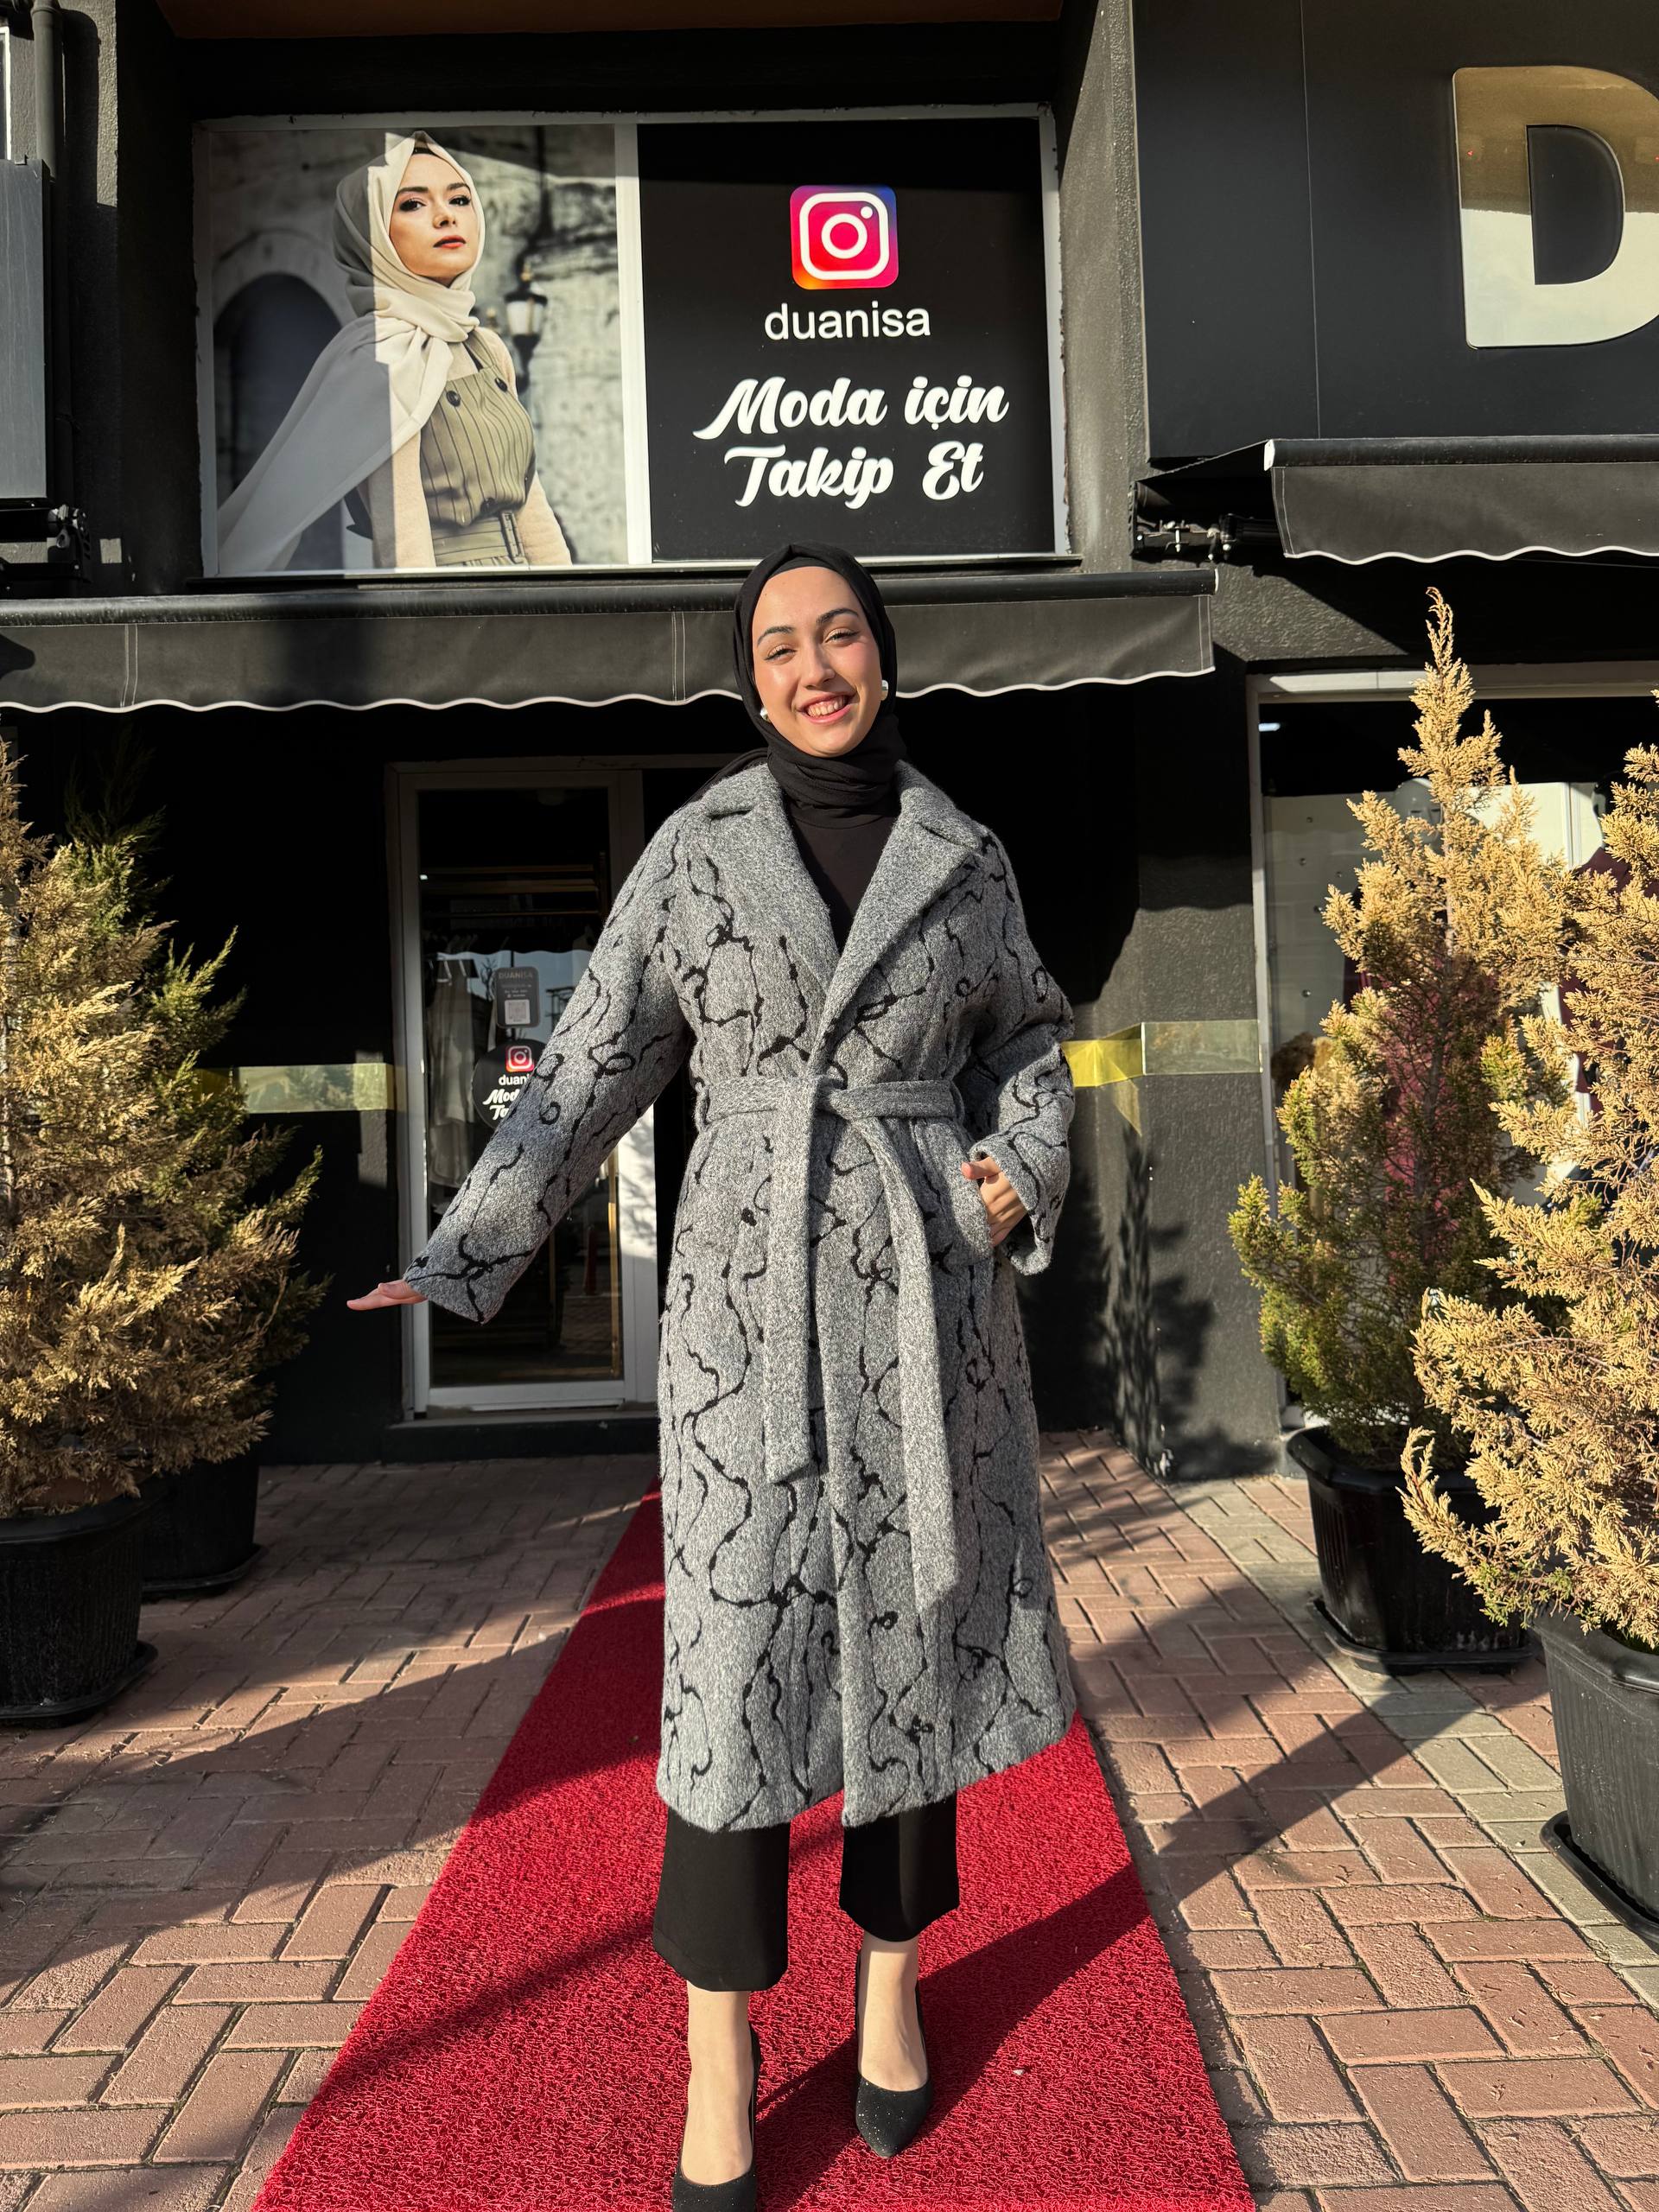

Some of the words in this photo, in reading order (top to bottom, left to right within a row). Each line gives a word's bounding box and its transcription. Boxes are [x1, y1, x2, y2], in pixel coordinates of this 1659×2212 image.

[1452, 65, 1659, 349] D
[765, 301, 931, 340] duanisa
[693, 376, 888, 440] Moda
[904, 374, 1010, 430] için
[723, 444, 894, 510] Takip
[922, 441, 984, 500] Et
